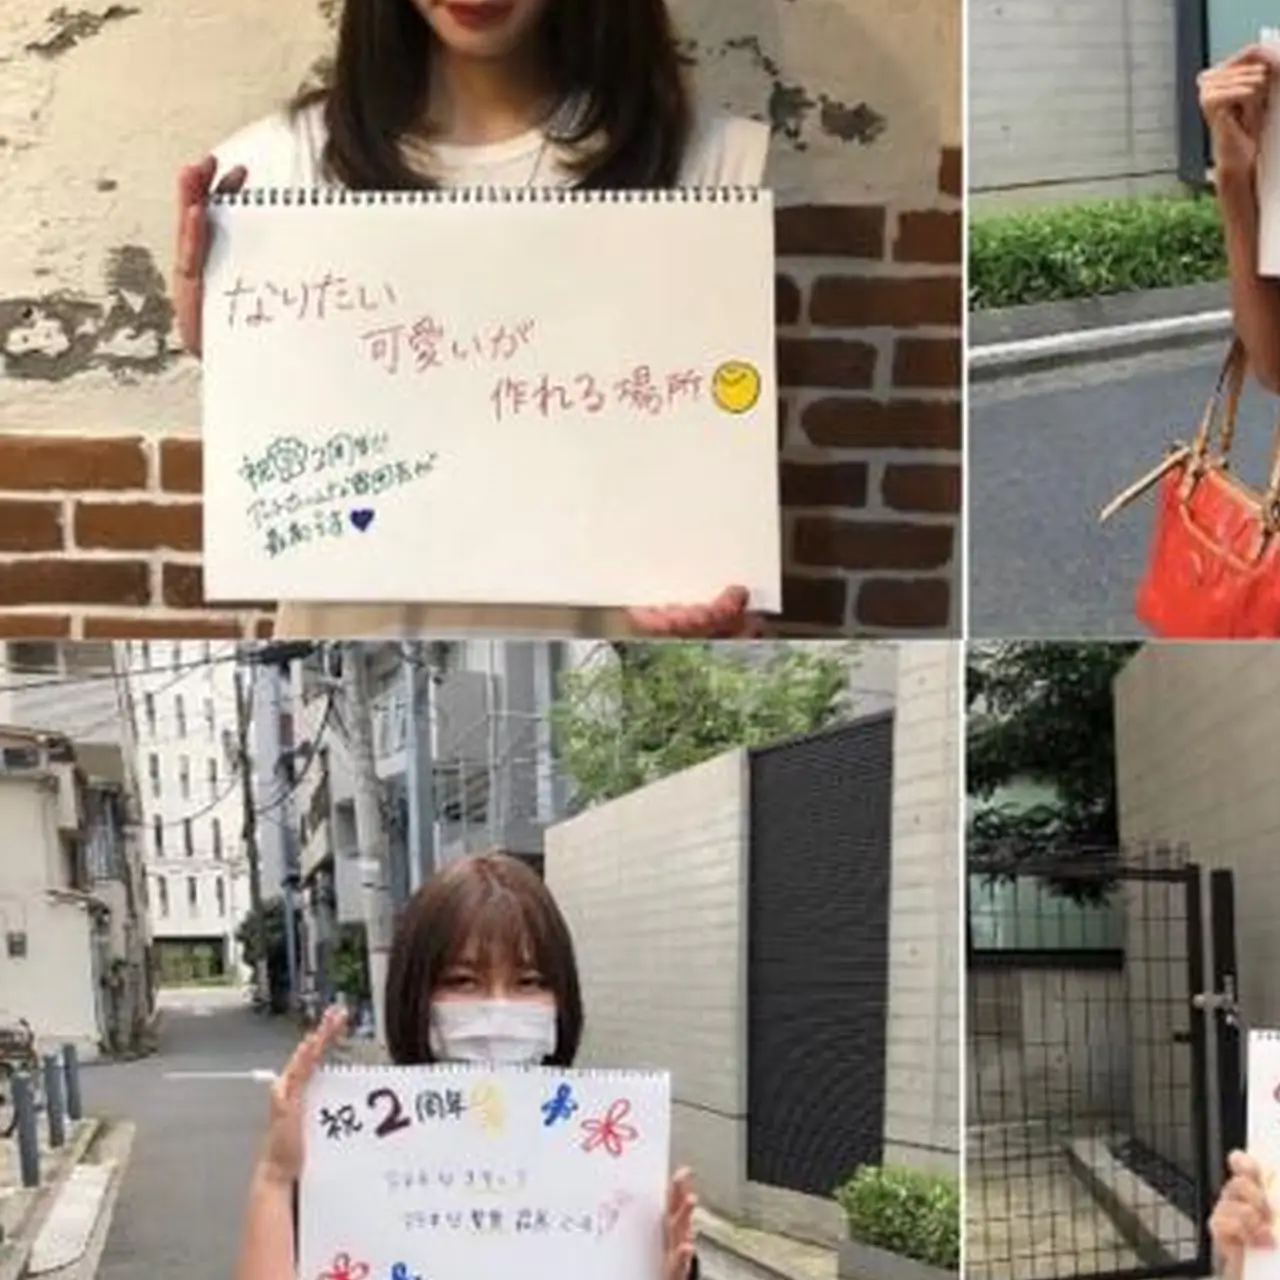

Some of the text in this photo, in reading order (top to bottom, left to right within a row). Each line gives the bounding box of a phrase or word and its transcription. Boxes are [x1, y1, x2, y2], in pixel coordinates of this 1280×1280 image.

[222, 271, 397, 328] なりたい
[359, 317, 537, 377] 可愛いが
[490, 363, 705, 422] 作れる場所
